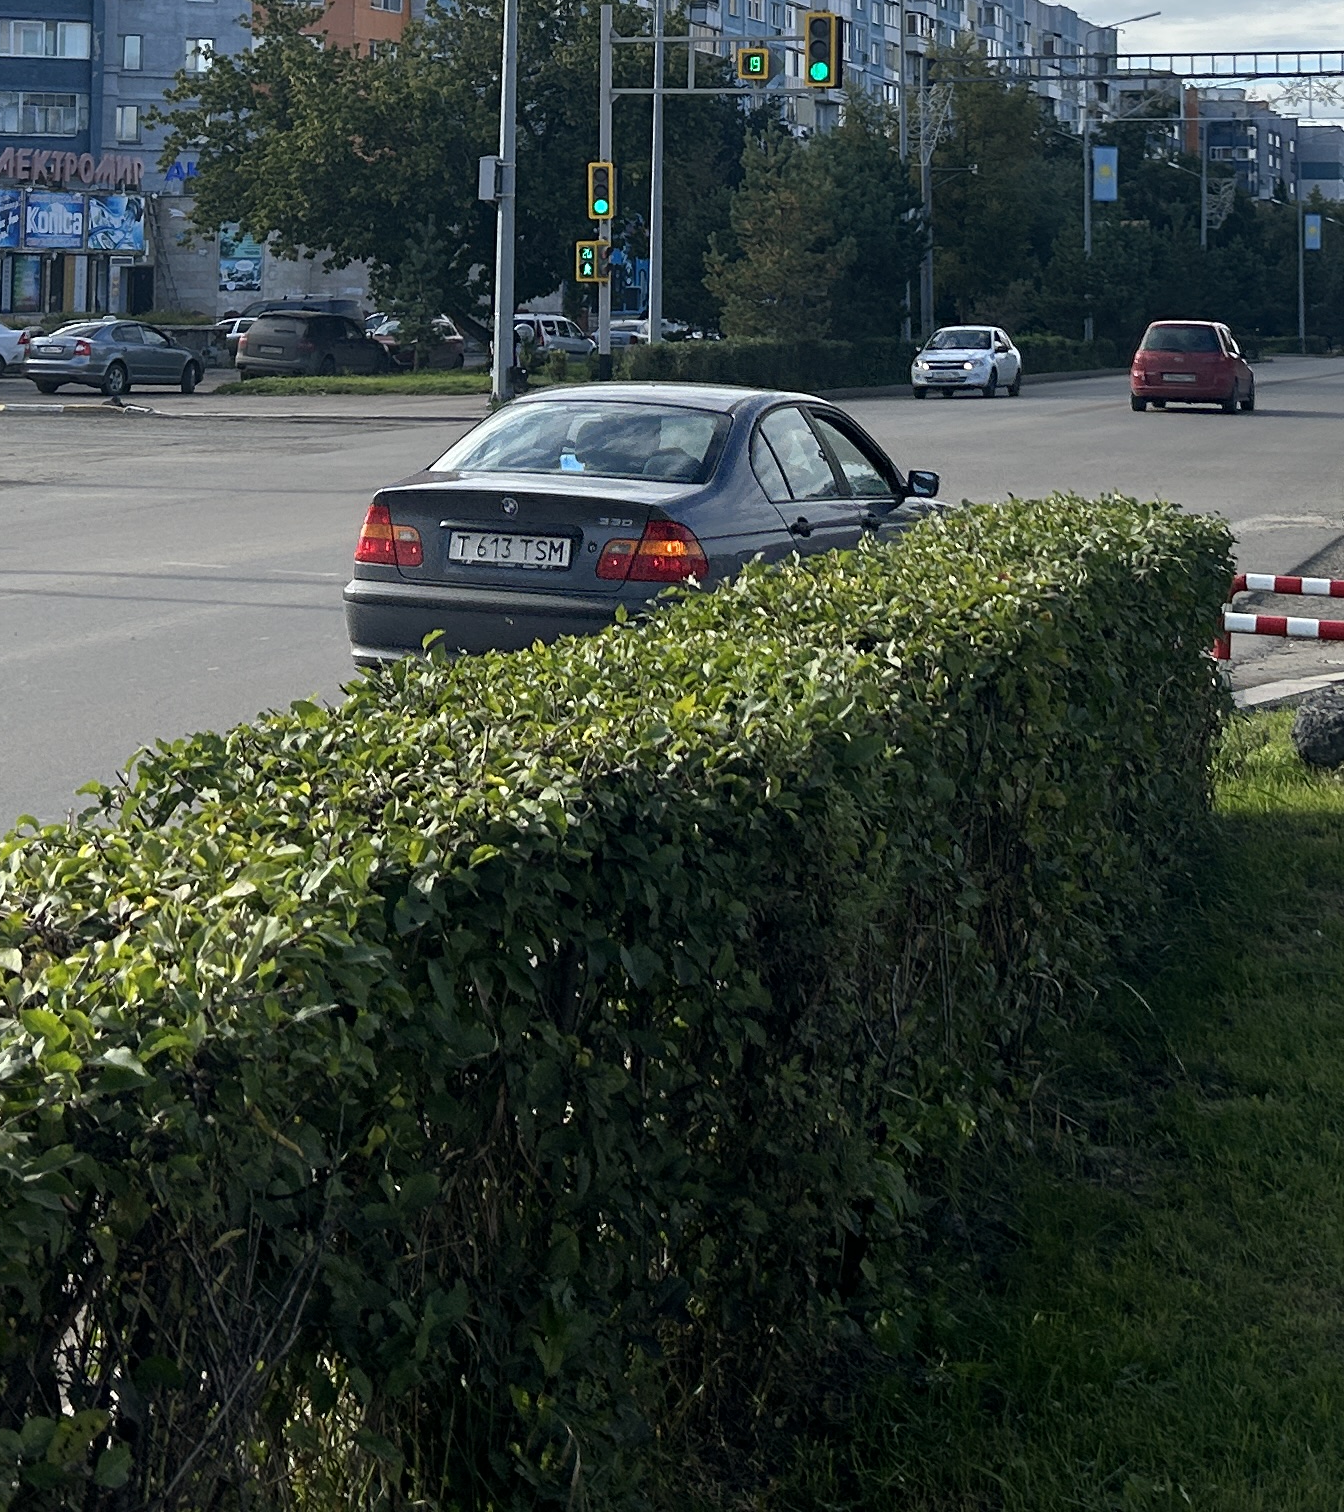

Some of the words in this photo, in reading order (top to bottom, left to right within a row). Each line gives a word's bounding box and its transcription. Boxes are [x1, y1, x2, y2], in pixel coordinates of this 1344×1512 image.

[457, 535, 471, 557] T
[476, 537, 512, 559] 613
[519, 539, 565, 563] TSM
